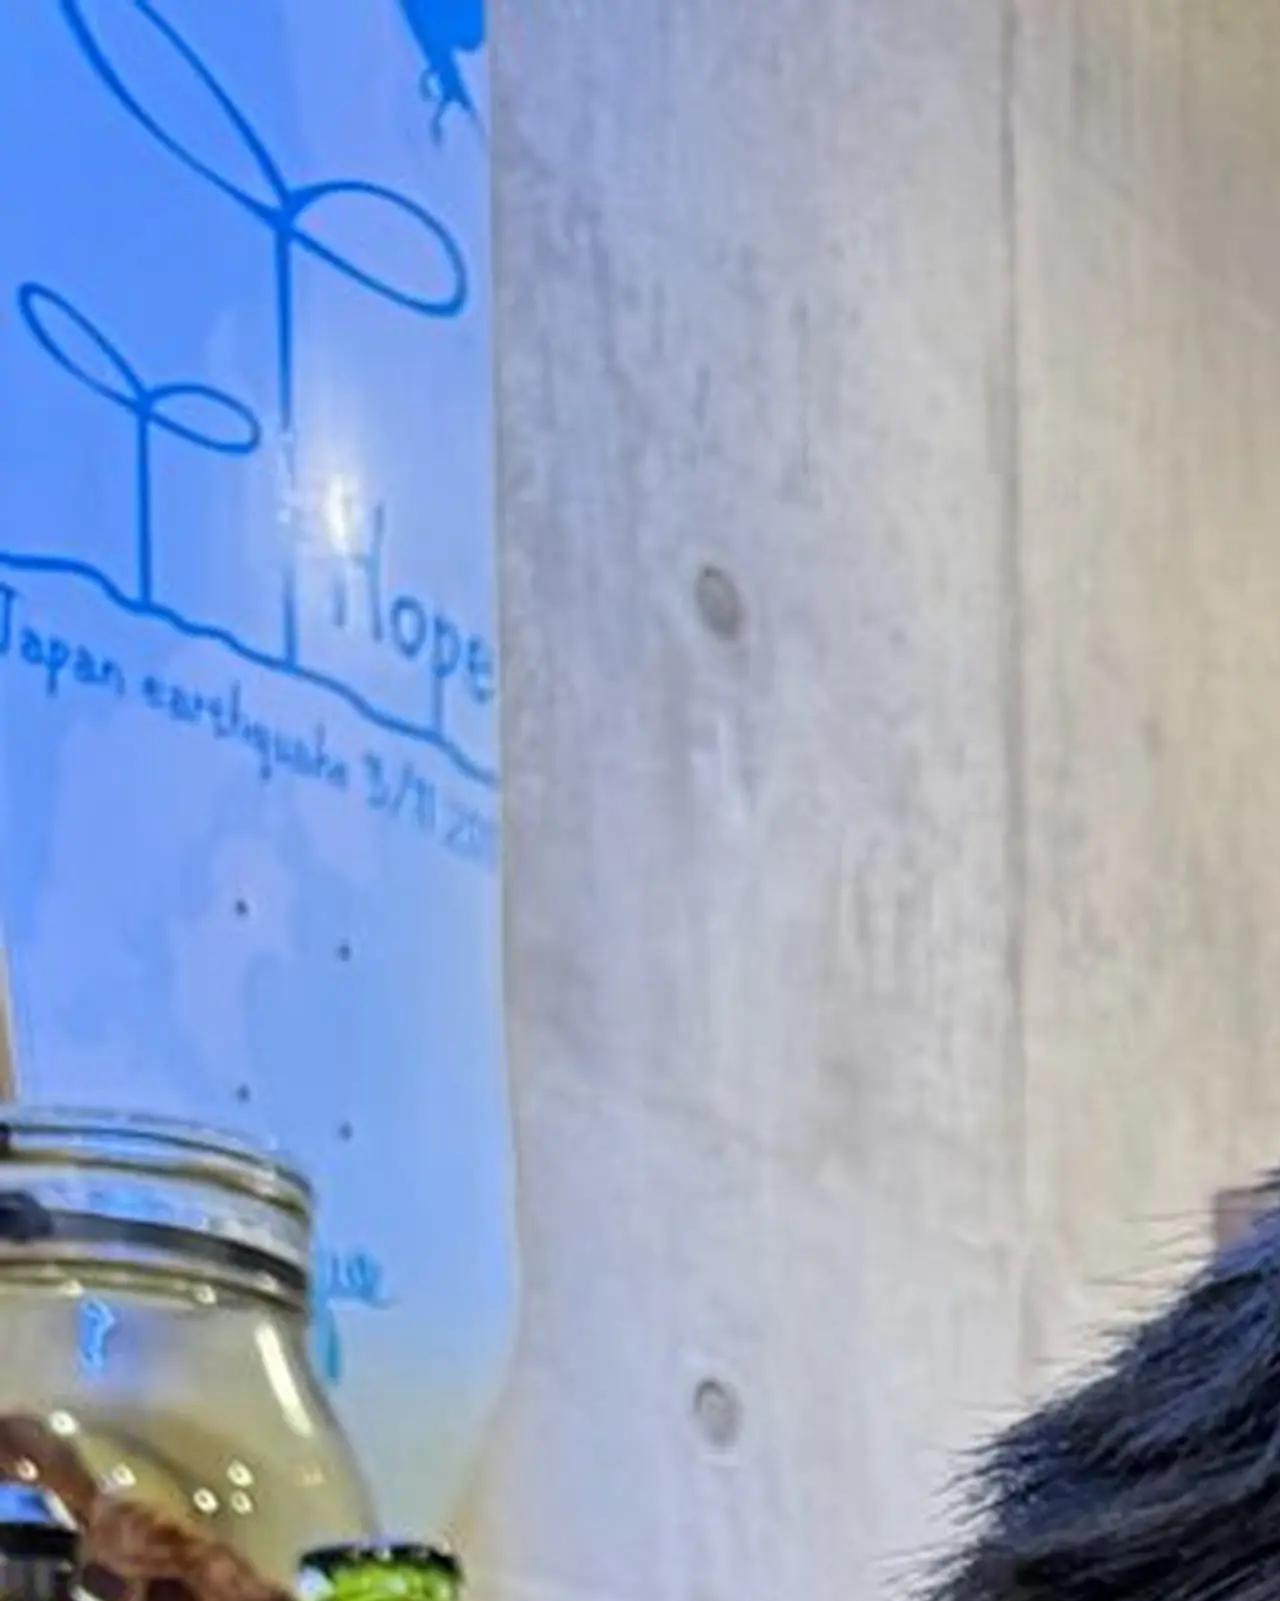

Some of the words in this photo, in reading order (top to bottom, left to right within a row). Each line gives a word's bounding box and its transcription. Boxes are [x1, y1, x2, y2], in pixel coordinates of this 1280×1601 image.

[0, 581, 126, 699] Japan
[142, 675, 347, 792] earthquake
[330, 502, 494, 737] Hope
